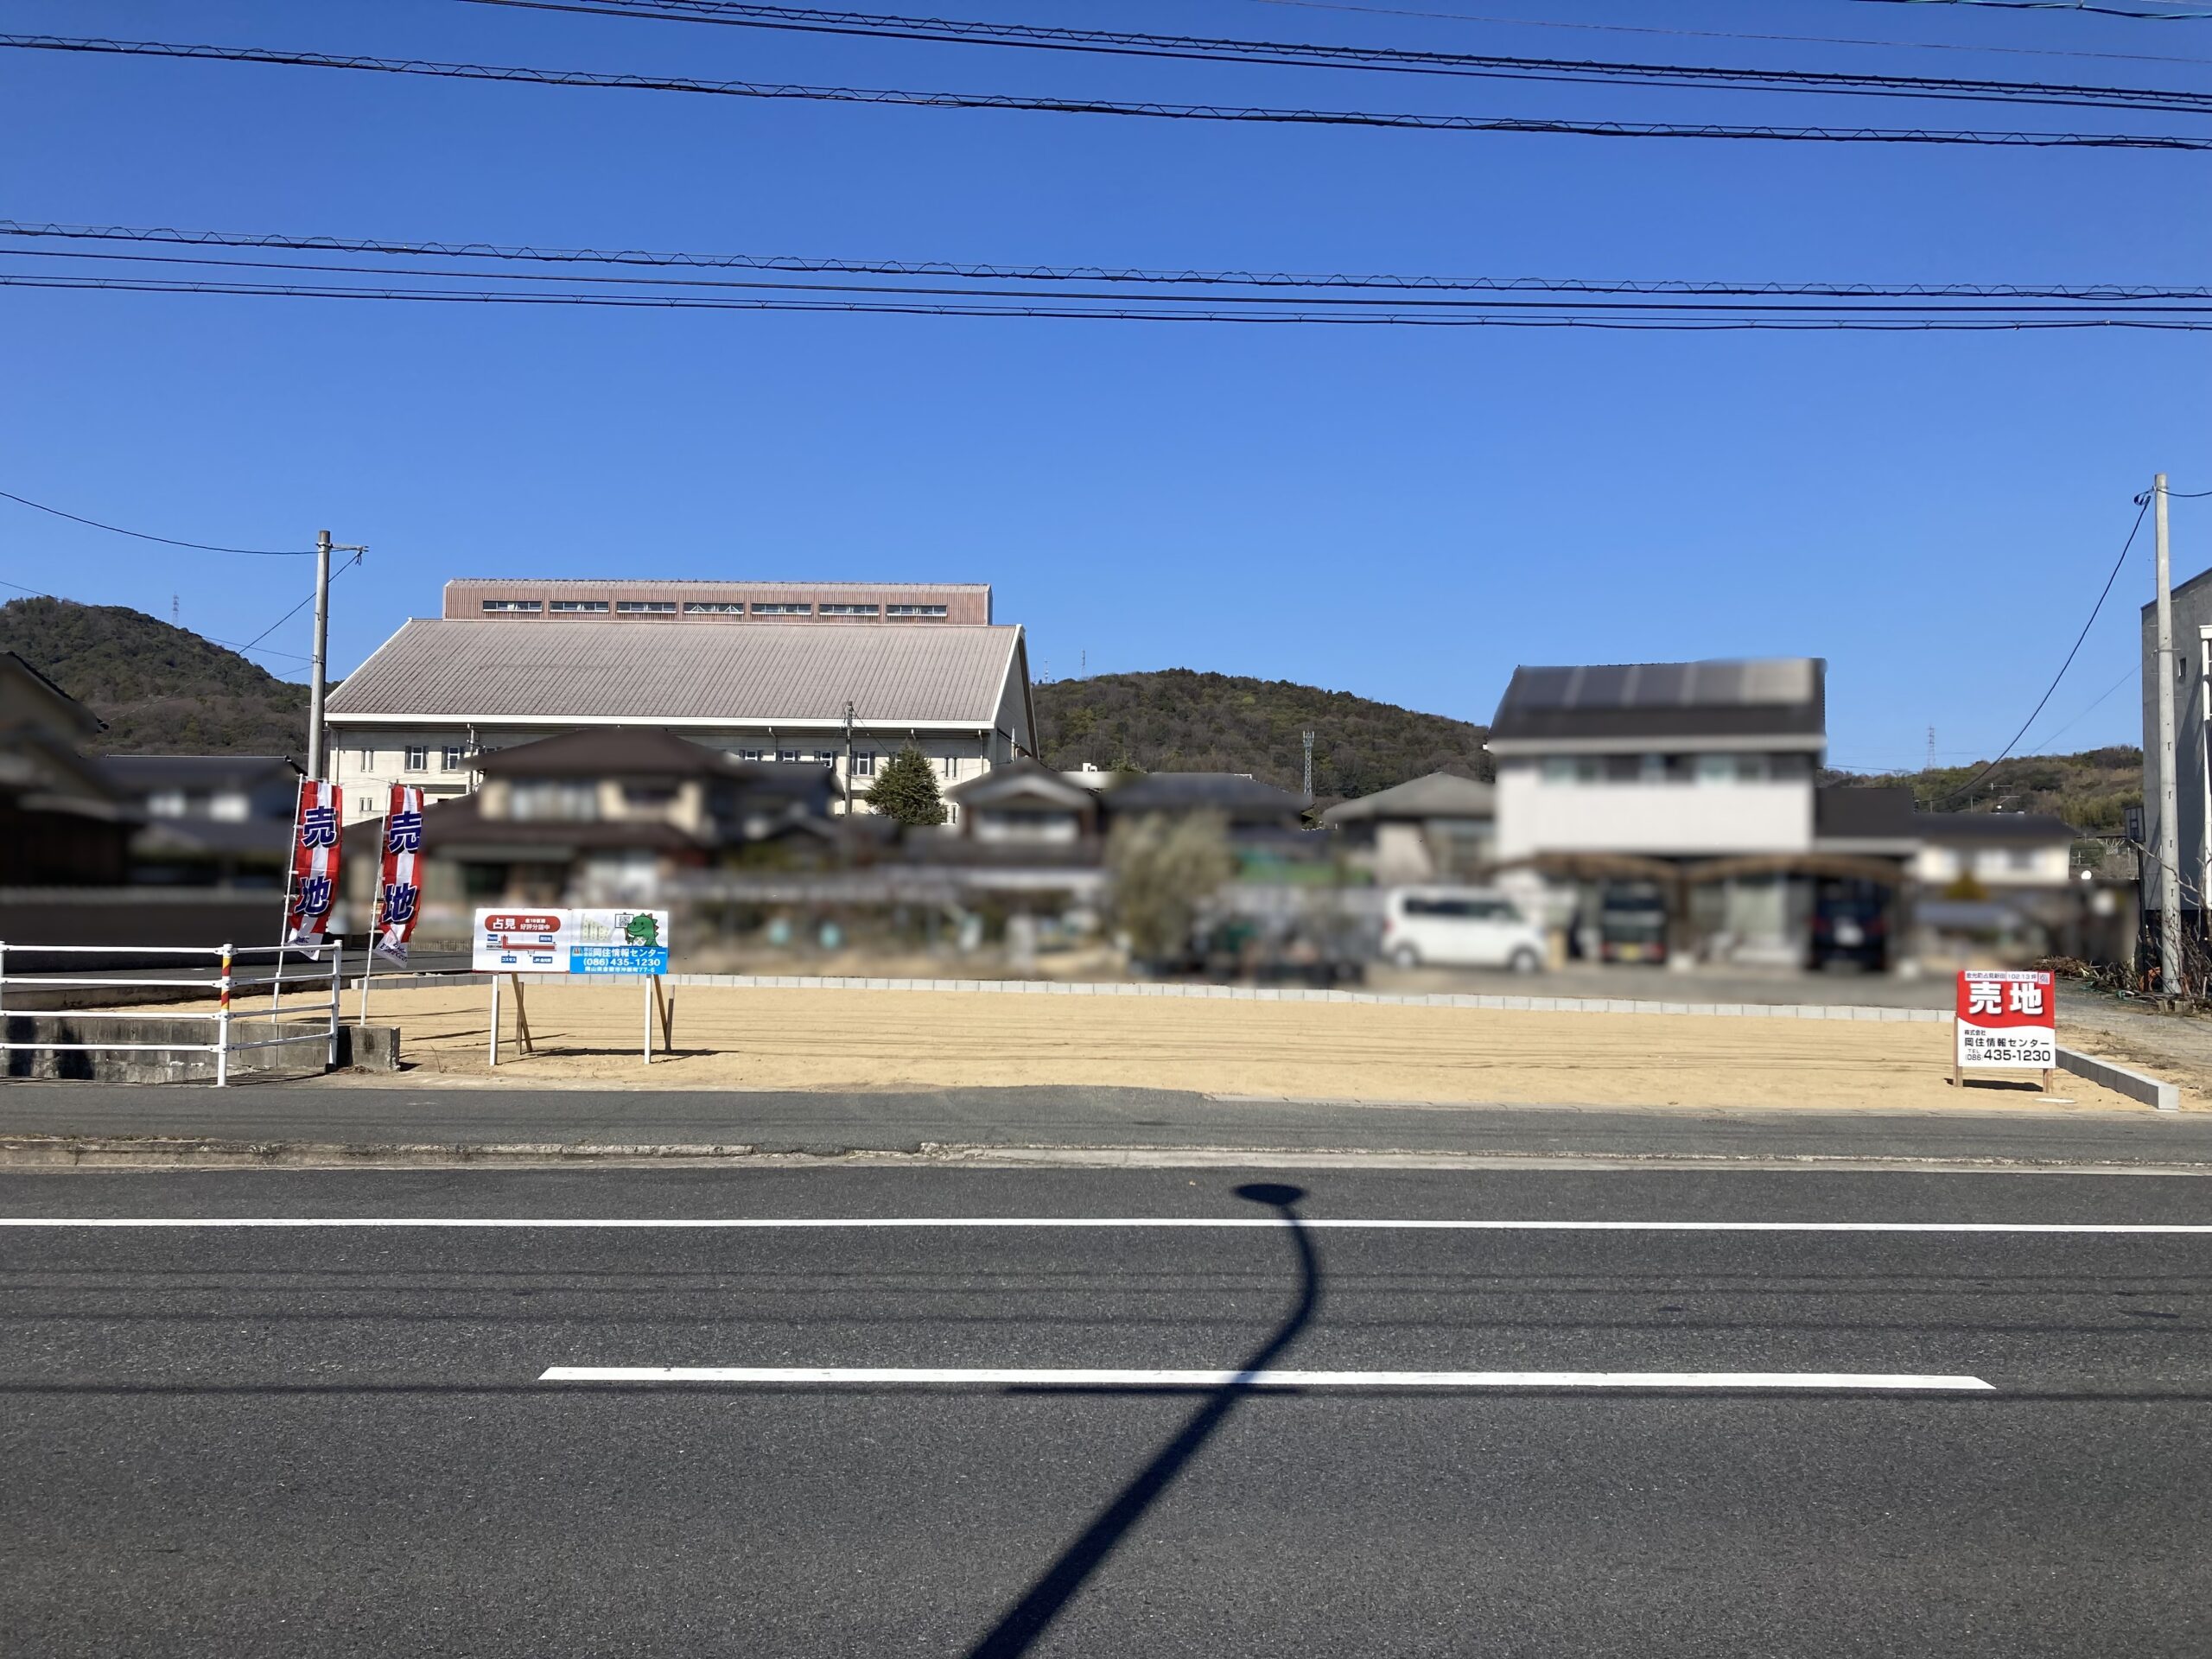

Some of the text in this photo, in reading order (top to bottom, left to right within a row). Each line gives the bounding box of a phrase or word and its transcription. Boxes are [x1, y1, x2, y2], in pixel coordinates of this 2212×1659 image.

[295, 805, 338, 917] 売地
[381, 810, 423, 925] 売地
[493, 918, 516, 930] 占見
[593, 948, 665, 957] 岡住情報センター
[1968, 982, 2044, 1014] 売地
[1964, 1037, 2050, 1047] 岡住情報センター
[1984, 1049, 2050, 1062] 435-1230
